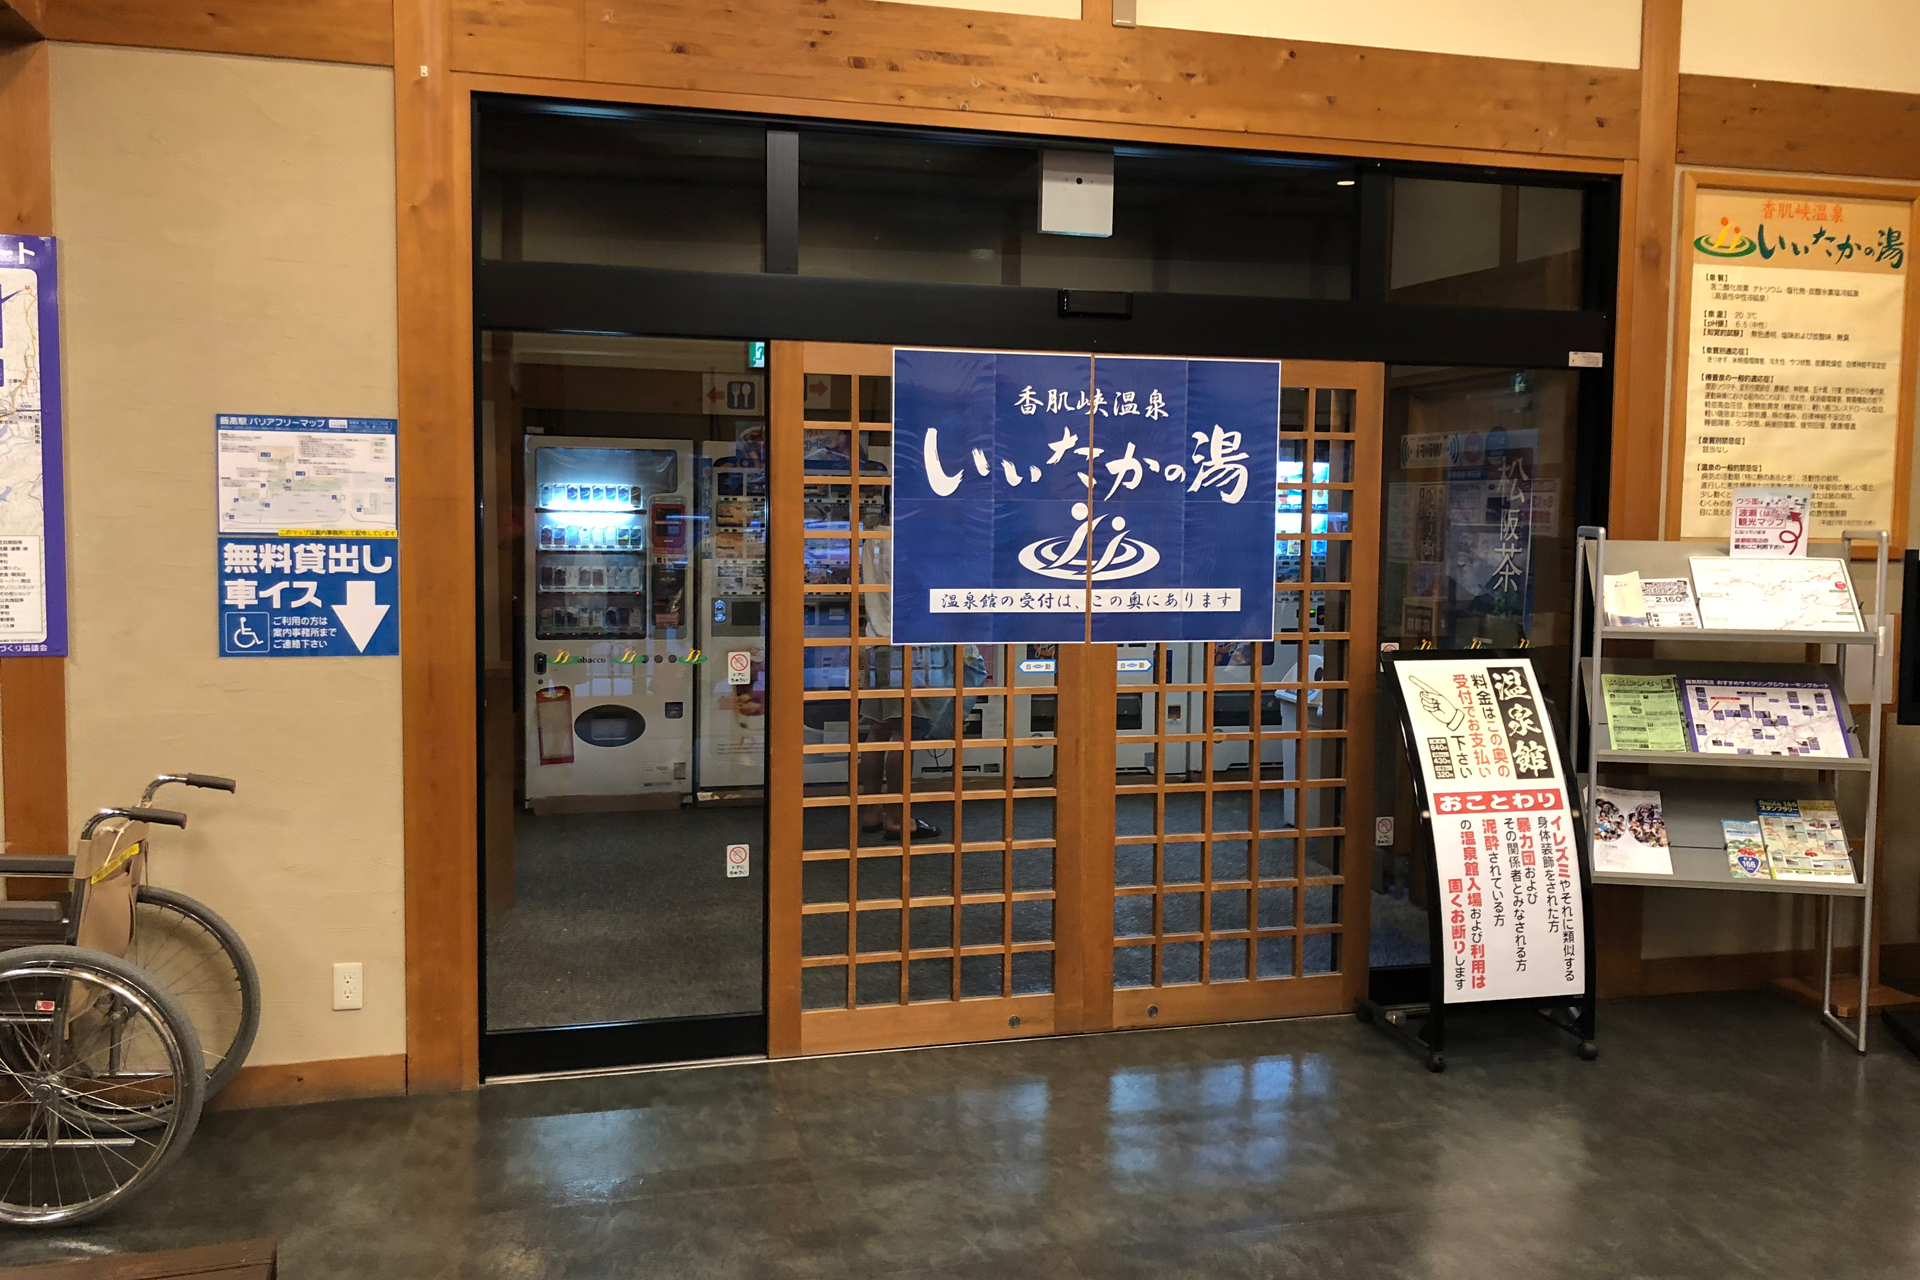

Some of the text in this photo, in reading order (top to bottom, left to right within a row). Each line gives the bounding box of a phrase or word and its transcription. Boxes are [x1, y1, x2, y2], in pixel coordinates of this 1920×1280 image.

[1762, 200, 1844, 223] 香肌峡温泉
[1757, 224, 1905, 269] いいたかの湯
[249, 417, 326, 428] バリアフリーマップ
[1014, 385, 1169, 419] 香肌峡温泉
[923, 424, 1249, 504] いいたかの湯
[1492, 457, 1529, 592] 松阪茶
[1738, 518, 1784, 526] 観光マップ
[223, 542, 393, 574] 無料貸出し
[224, 578, 322, 609] 車イス
[941, 590, 1232, 610] 温泉館の受付は、この奥にあります
[272, 616, 328, 626] ご利用の方は
[272, 627, 337, 637] 案内事務所まで
[273, 639, 327, 649] ご連絡下さい
[574, 655, 607, 664] obacco
[1453, 674, 1492, 778] 受付でお支払い
[1471, 673, 1510, 778] 料金はこの奥の
[1492, 669, 1548, 777] 温泉館
[1451, 735, 1473, 778] 下さい
[1439, 792, 1556, 812] おことわり
[1482, 818, 1505, 927] 泥酔されている方
[1516, 817, 1538, 905] 暴力団および
[1537, 816, 1559, 933] 身体装飾をされた方
[1460, 819, 1486, 989] の温泉館入場および利用は
[1504, 818, 1527, 972] その関係者とみなされる方
[1550, 816, 1575, 982] イレズミやそれに類似する
[1448, 879, 1466, 990] 固くお断りします
